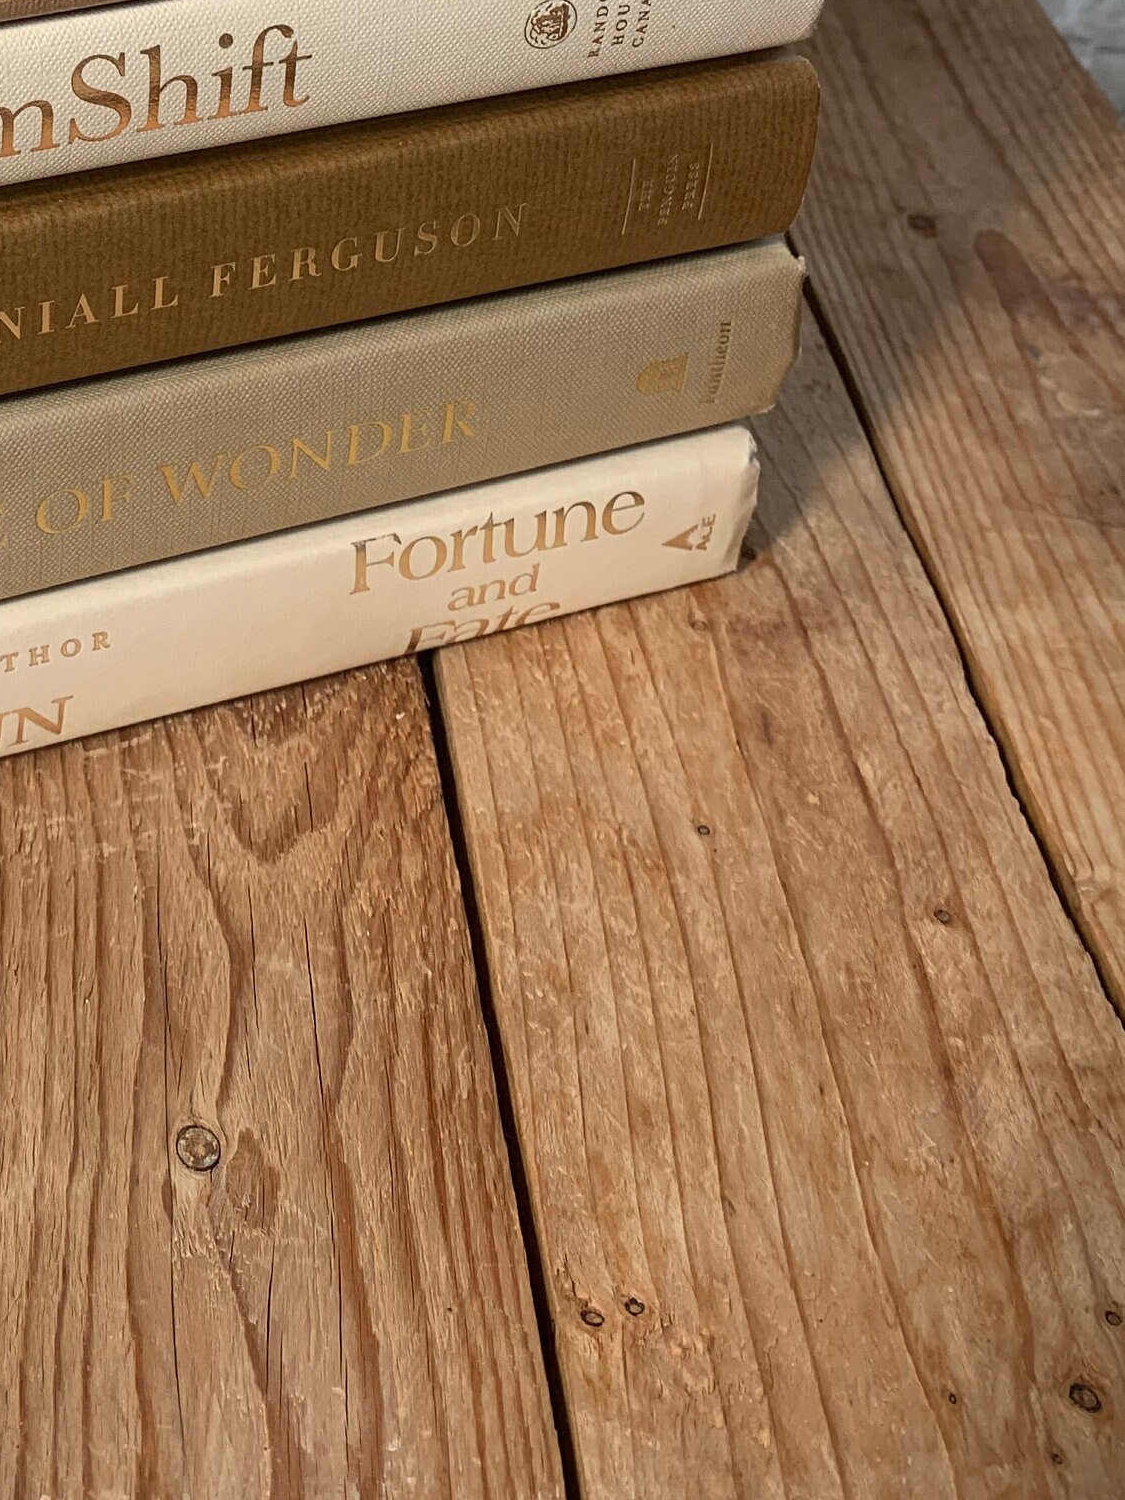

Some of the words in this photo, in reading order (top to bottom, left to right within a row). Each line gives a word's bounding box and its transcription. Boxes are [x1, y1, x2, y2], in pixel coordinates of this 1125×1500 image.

[208, 202, 529, 299] FERGUSON
[36, 476, 131, 535] OF
[159, 399, 477, 502] WONDER
[349, 491, 646, 595] Fortune
[447, 562, 540, 611] and
